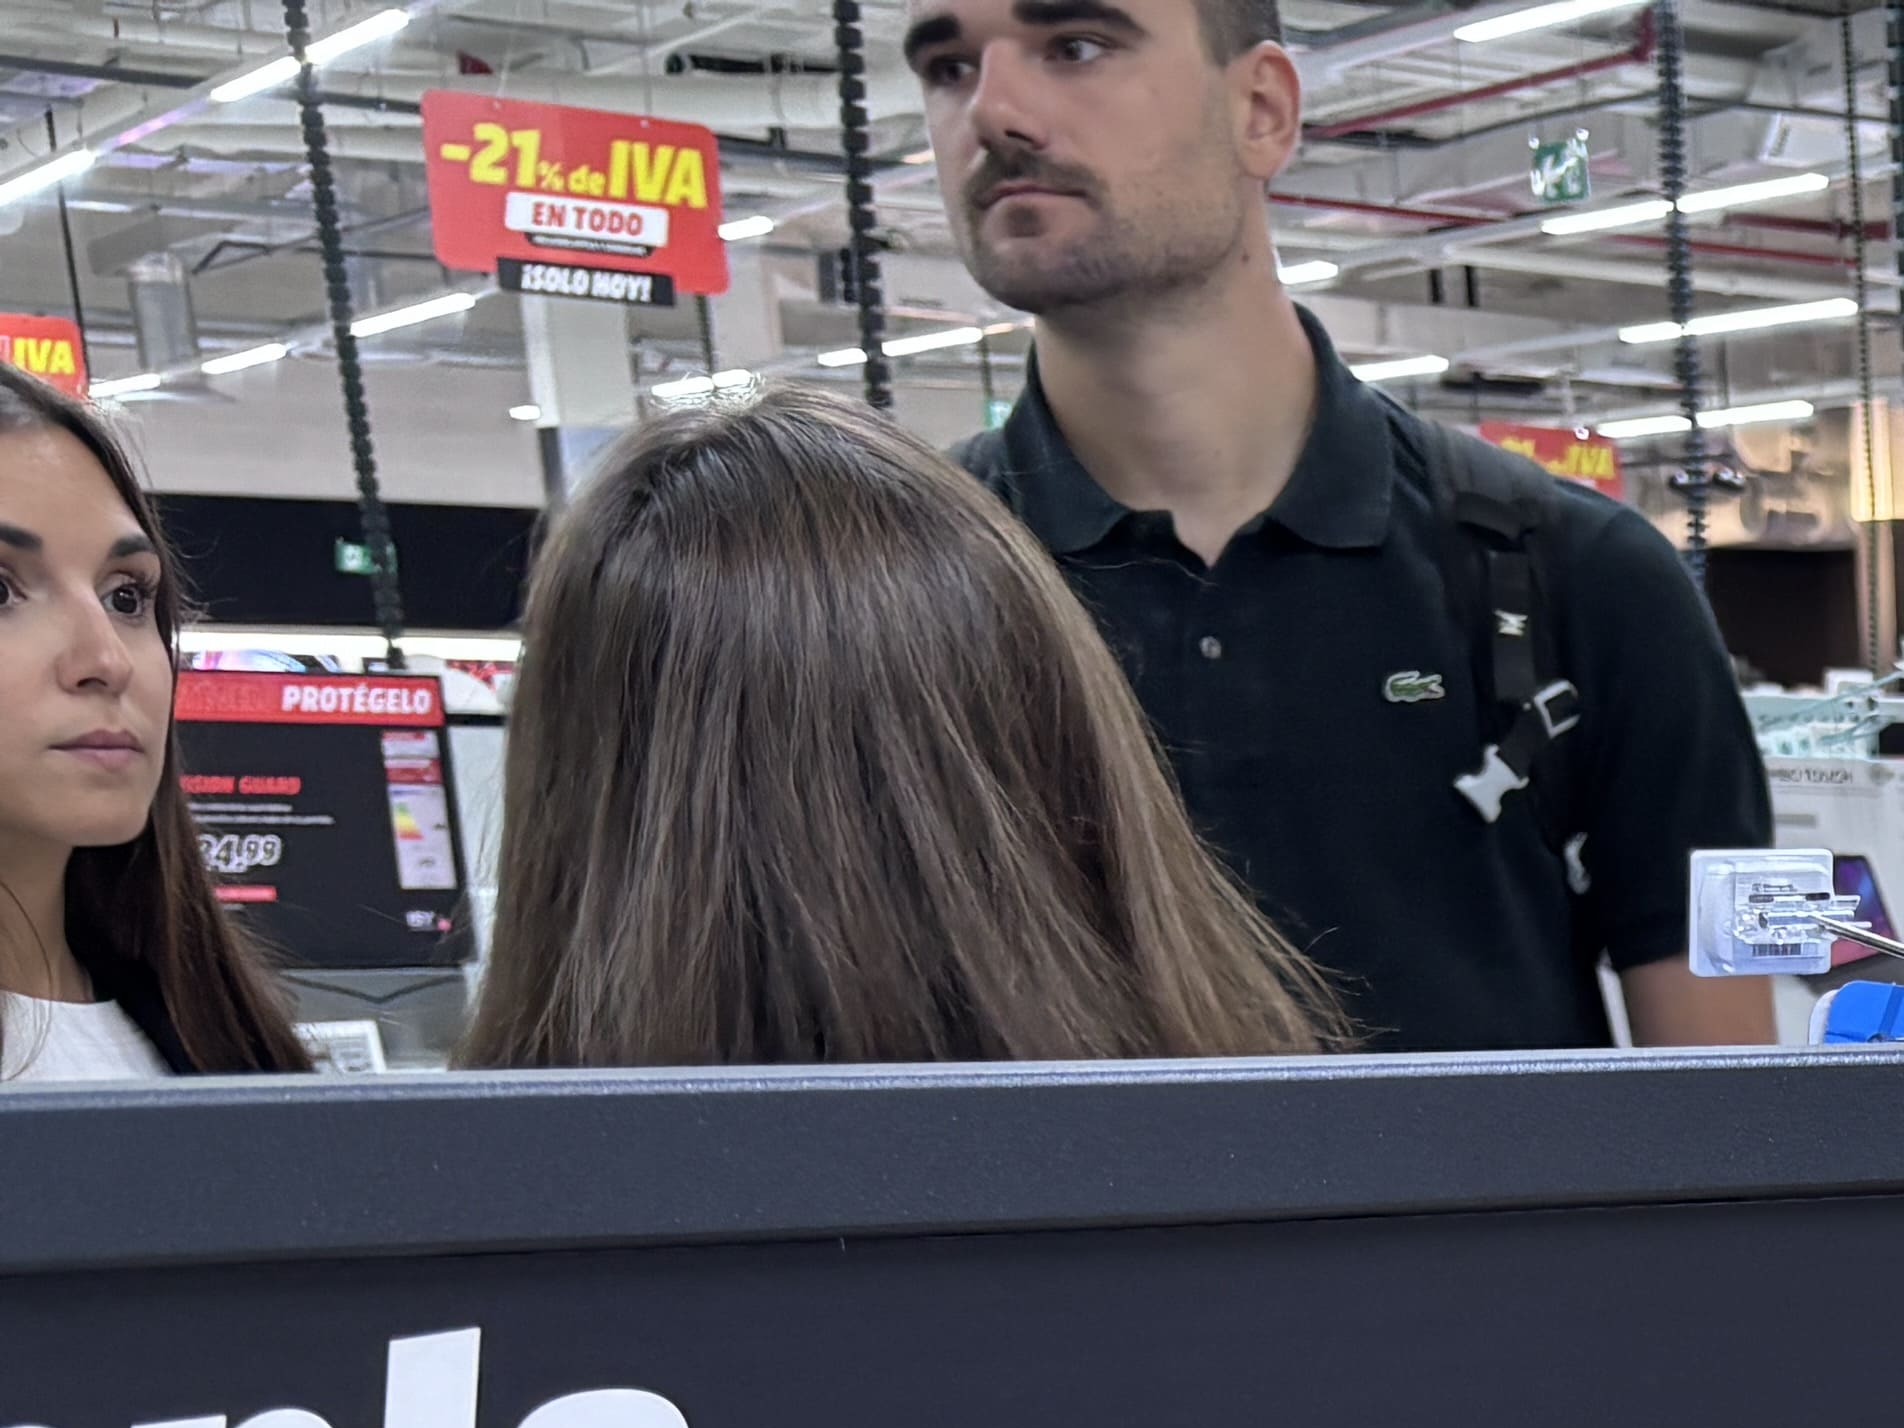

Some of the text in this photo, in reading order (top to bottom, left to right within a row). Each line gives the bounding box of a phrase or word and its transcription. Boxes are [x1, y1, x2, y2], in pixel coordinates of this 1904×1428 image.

[608, 139, 708, 208] IVA
[531, 201, 644, 237] EN TODO
[13, 336, 77, 375] IVA
[281, 683, 433, 715] PROTÉGELO
